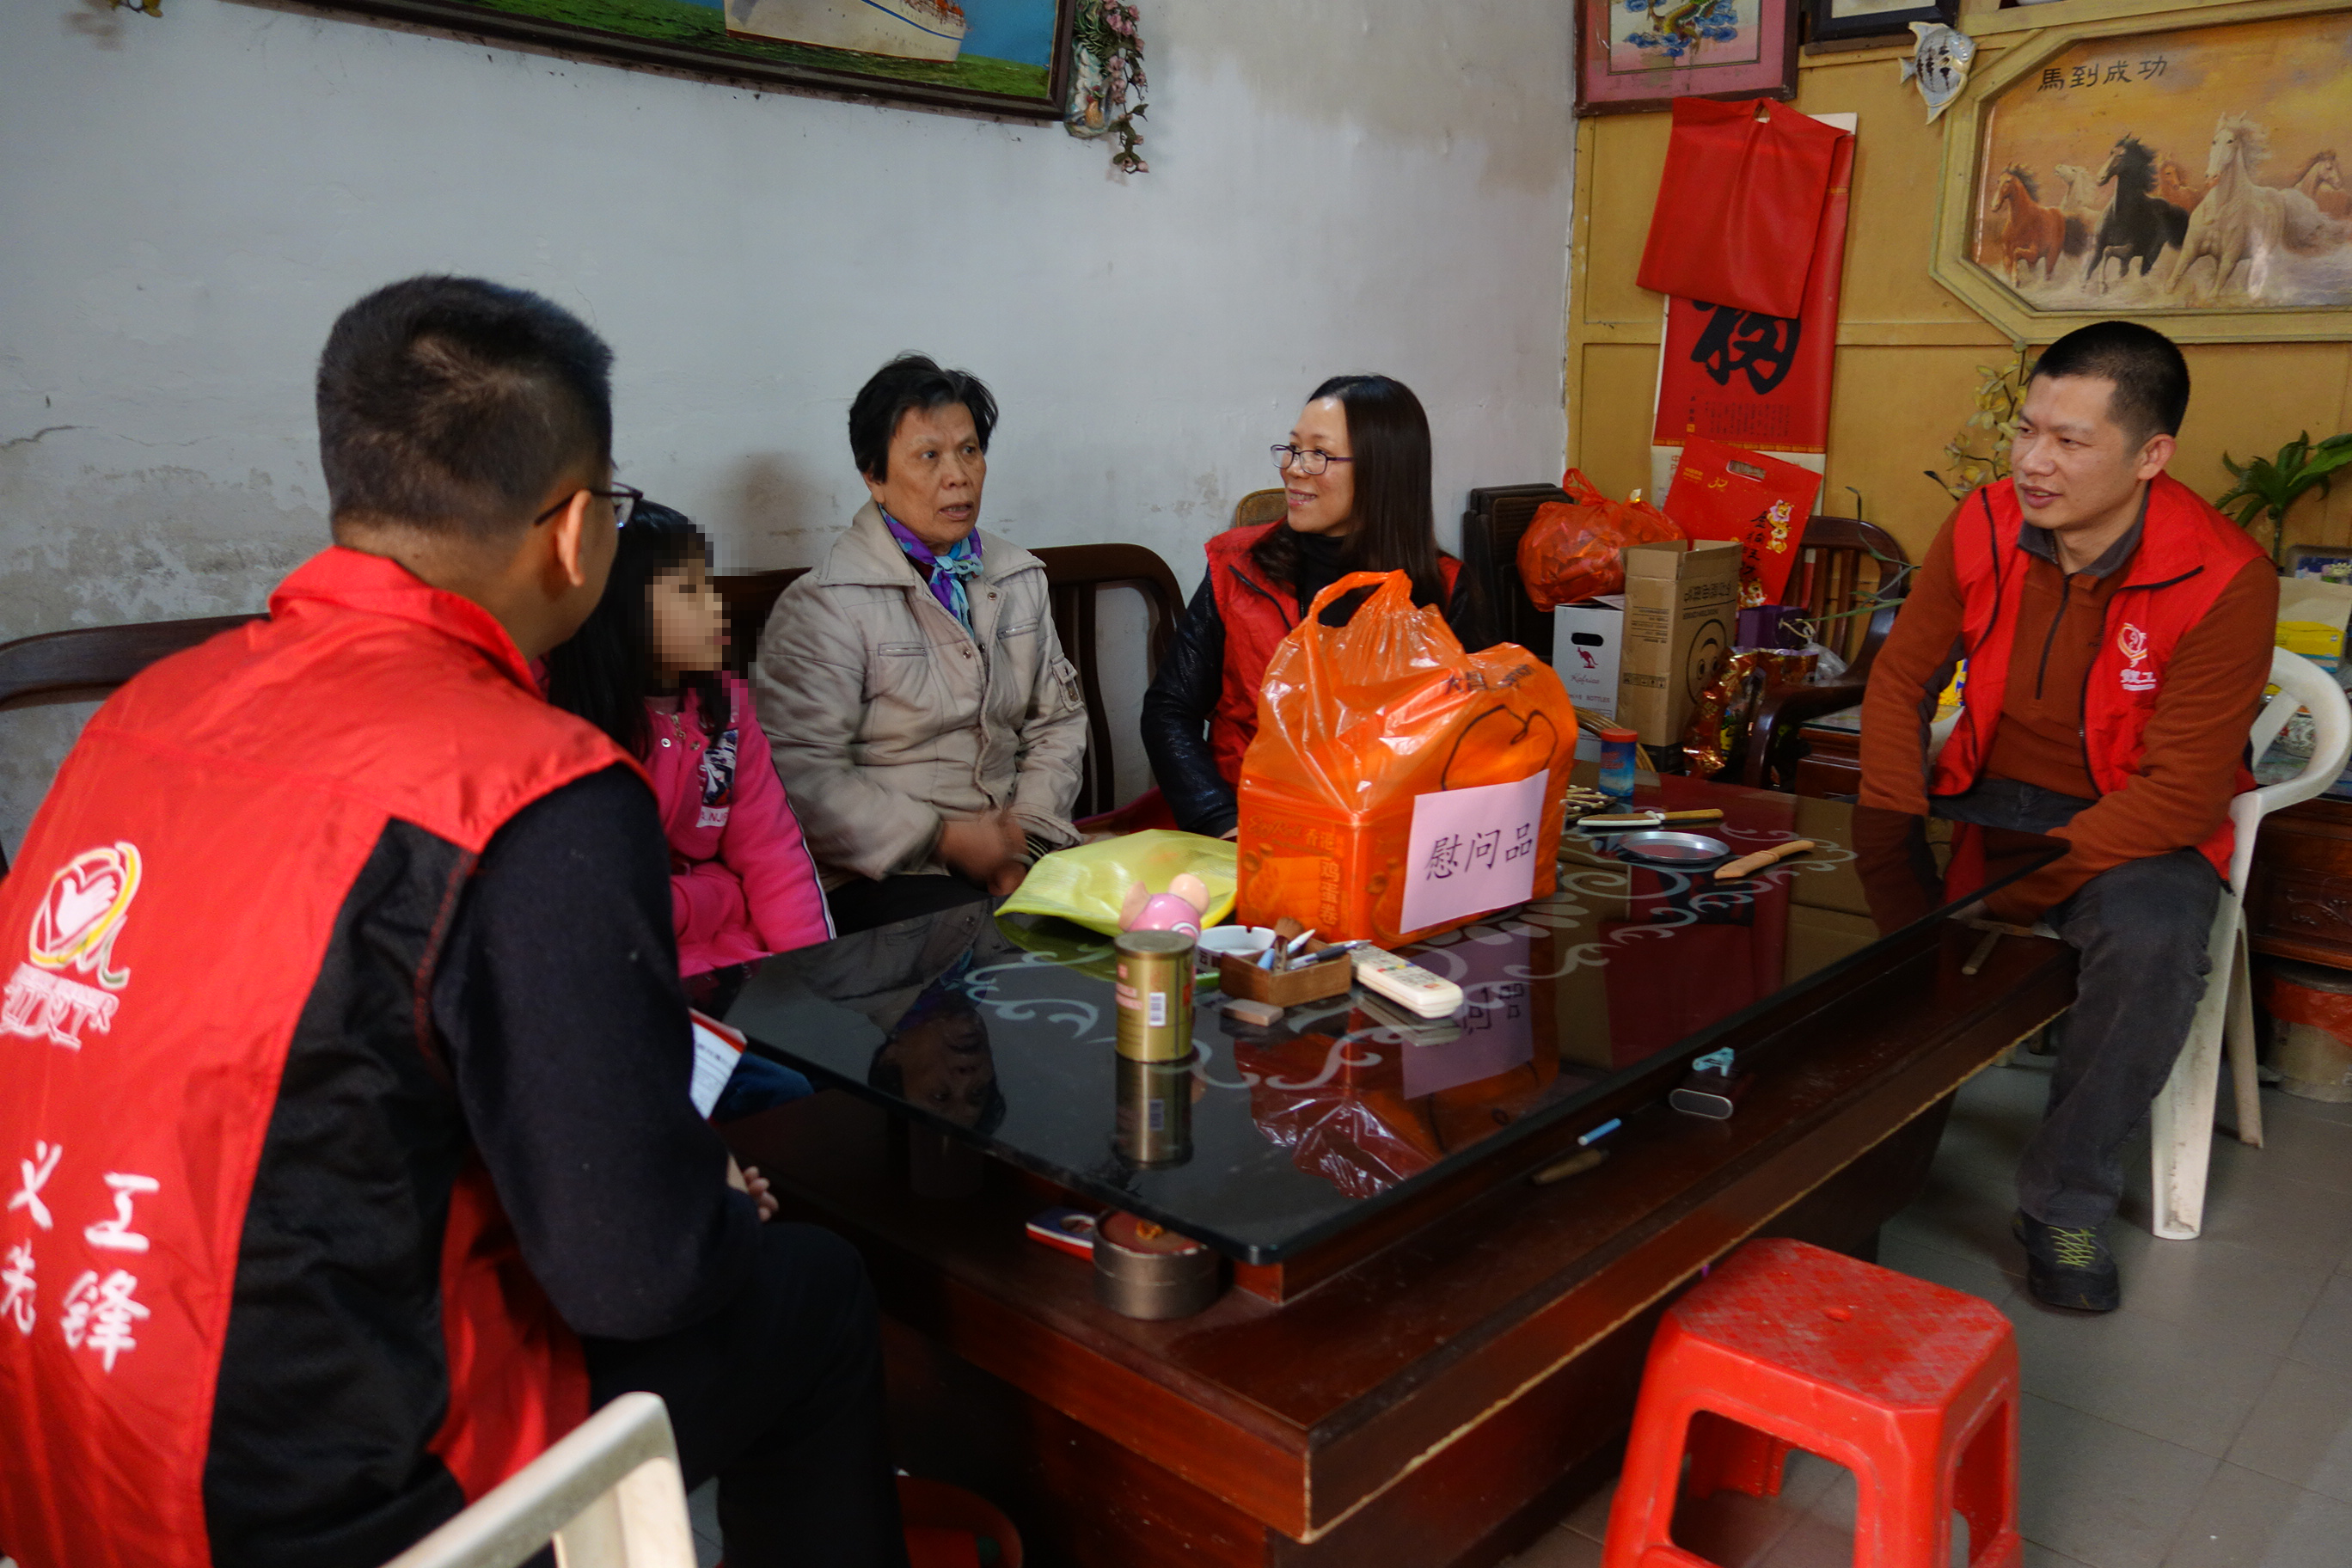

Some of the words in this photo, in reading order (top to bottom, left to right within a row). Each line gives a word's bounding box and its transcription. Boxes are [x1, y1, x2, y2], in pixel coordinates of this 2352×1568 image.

[2037, 55, 2169, 92] 馬到成功
[1586, 695, 1610, 703] BOTTLES
[1424, 822, 1534, 881] 慰问品
[1320, 861, 1341, 926] 鸡蛋卷
[7, 1139, 161, 1253] 义工
